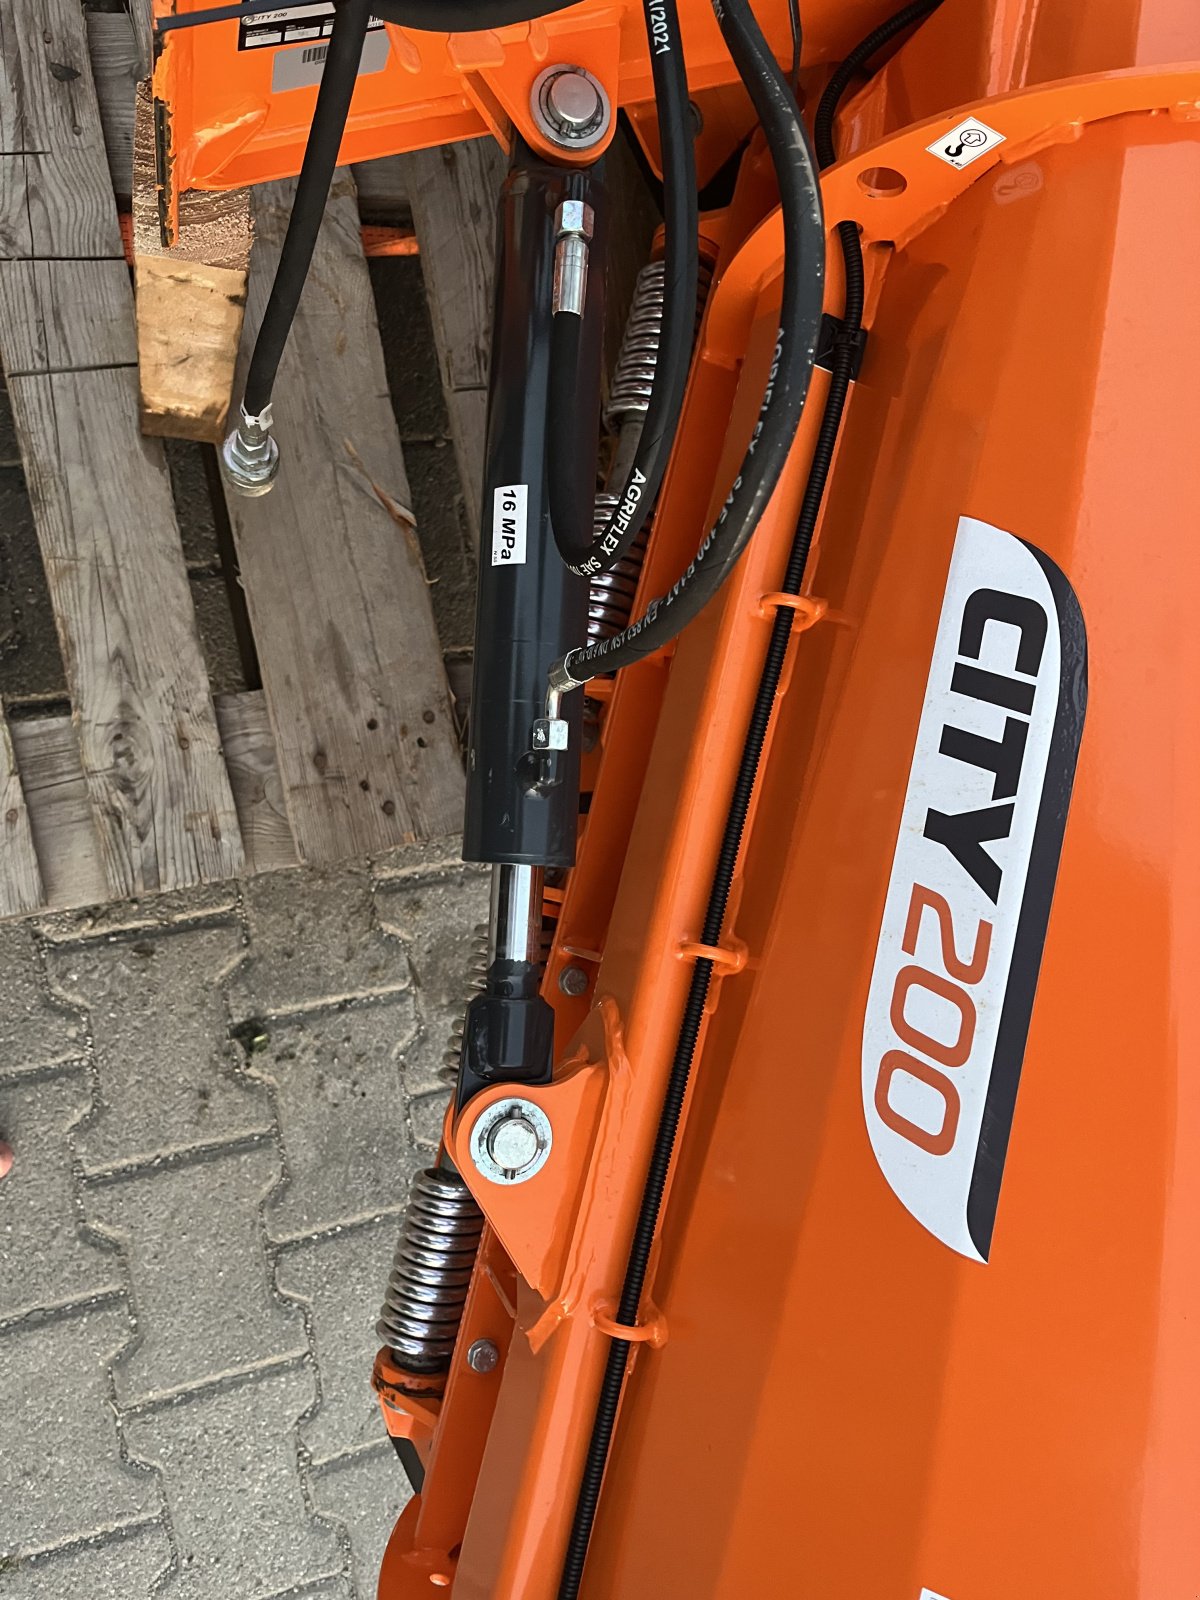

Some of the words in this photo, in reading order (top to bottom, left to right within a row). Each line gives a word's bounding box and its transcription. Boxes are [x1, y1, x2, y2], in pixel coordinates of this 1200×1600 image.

[502, 489, 517, 512] 16
[600, 467, 647, 556] AGRIFLEX
[501, 517, 516, 560] MPa
[580, 556, 602, 575] SAE
